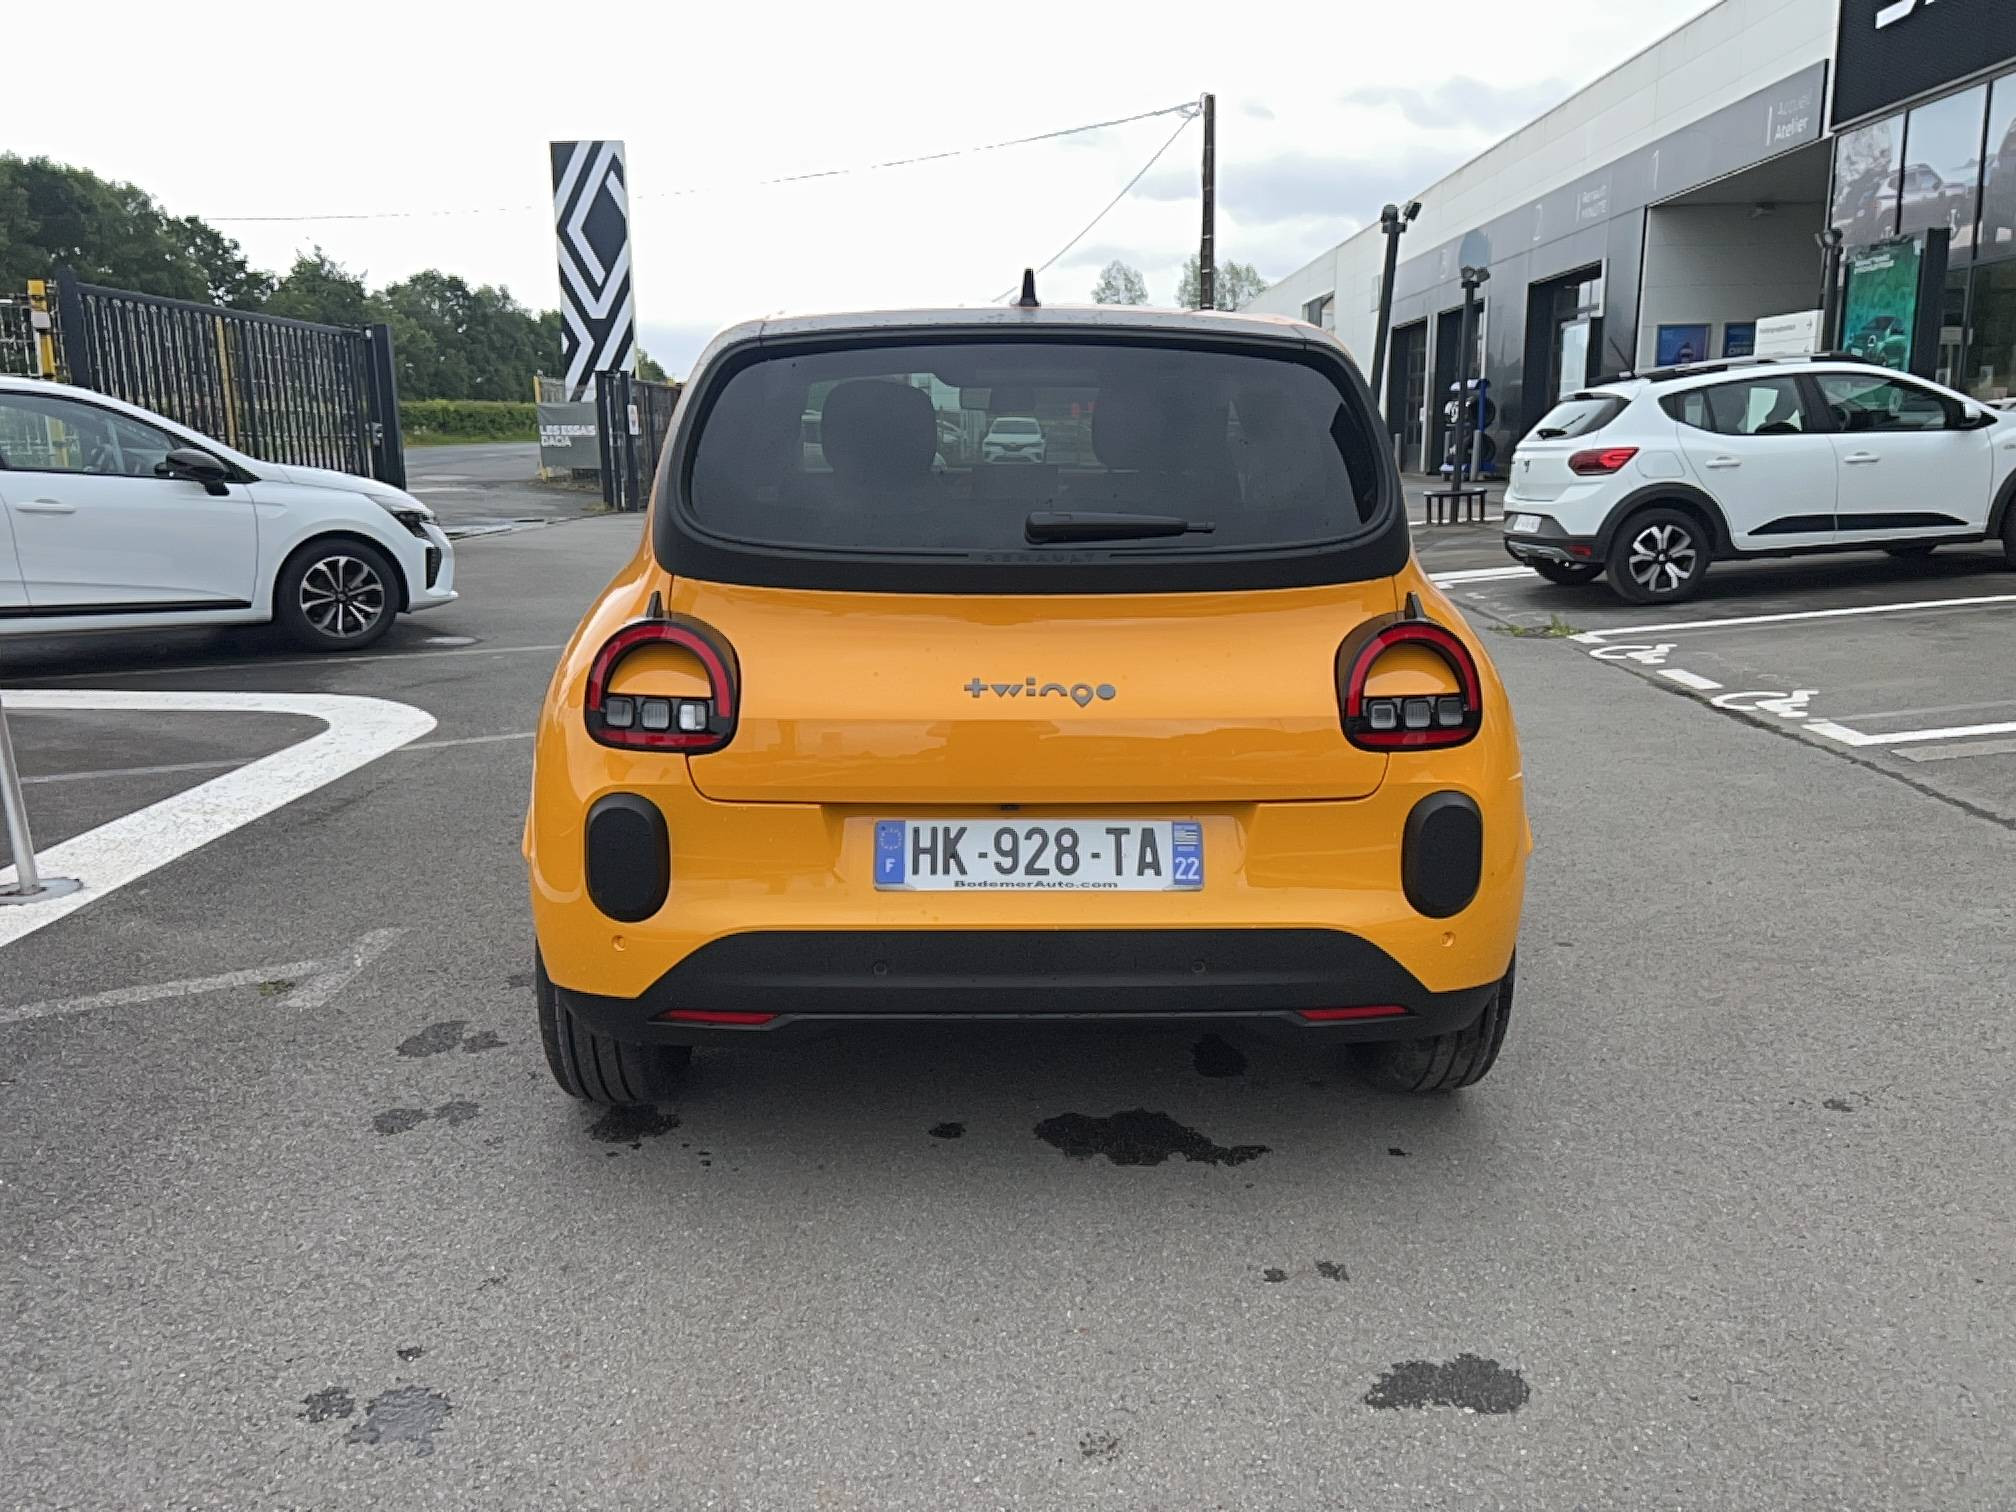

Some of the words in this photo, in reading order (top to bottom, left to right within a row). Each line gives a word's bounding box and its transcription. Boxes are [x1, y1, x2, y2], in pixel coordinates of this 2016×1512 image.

[964, 677, 1117, 707] twingo
[885, 858, 896, 873] F
[912, 826, 1162, 876] HK-928-TA
[1175, 857, 1200, 879] 22
[953, 880, 1119, 889] BodemerAuto.com
